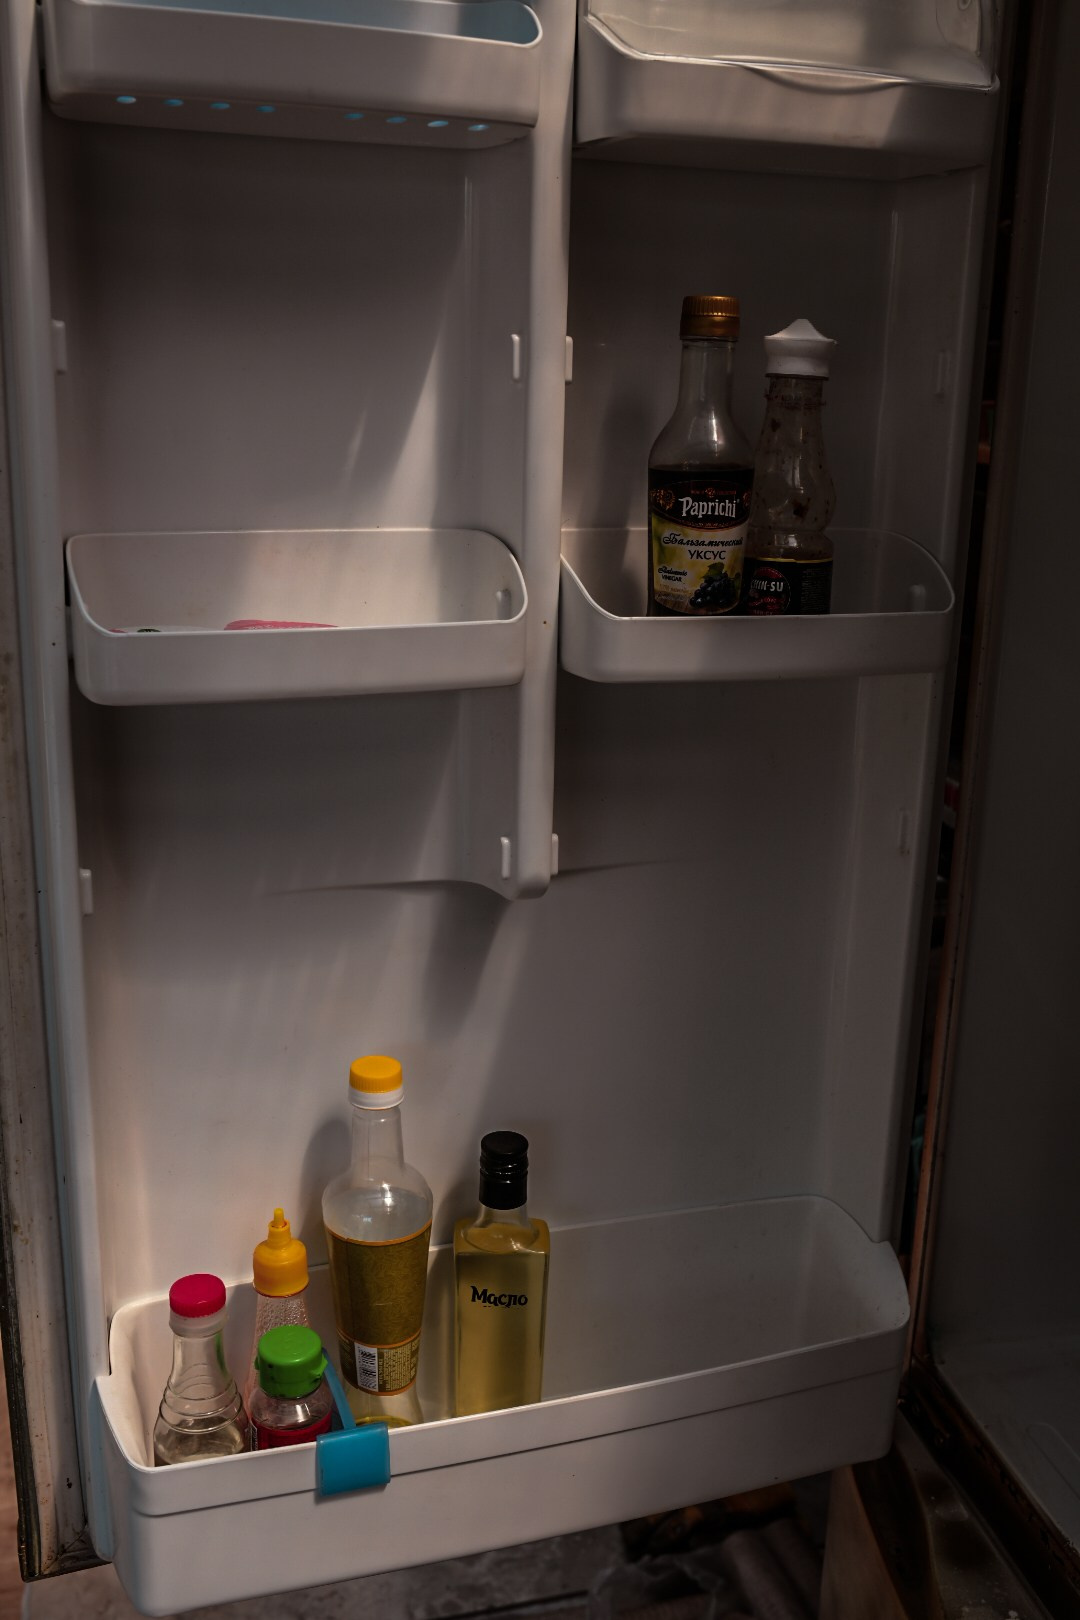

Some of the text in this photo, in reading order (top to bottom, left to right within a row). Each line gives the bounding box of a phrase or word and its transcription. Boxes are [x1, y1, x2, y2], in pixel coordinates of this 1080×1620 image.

[678, 496, 737, 519] Paprichi
[688, 549, 727, 560] УКСУС
[470, 1285, 529, 1308] Масло
